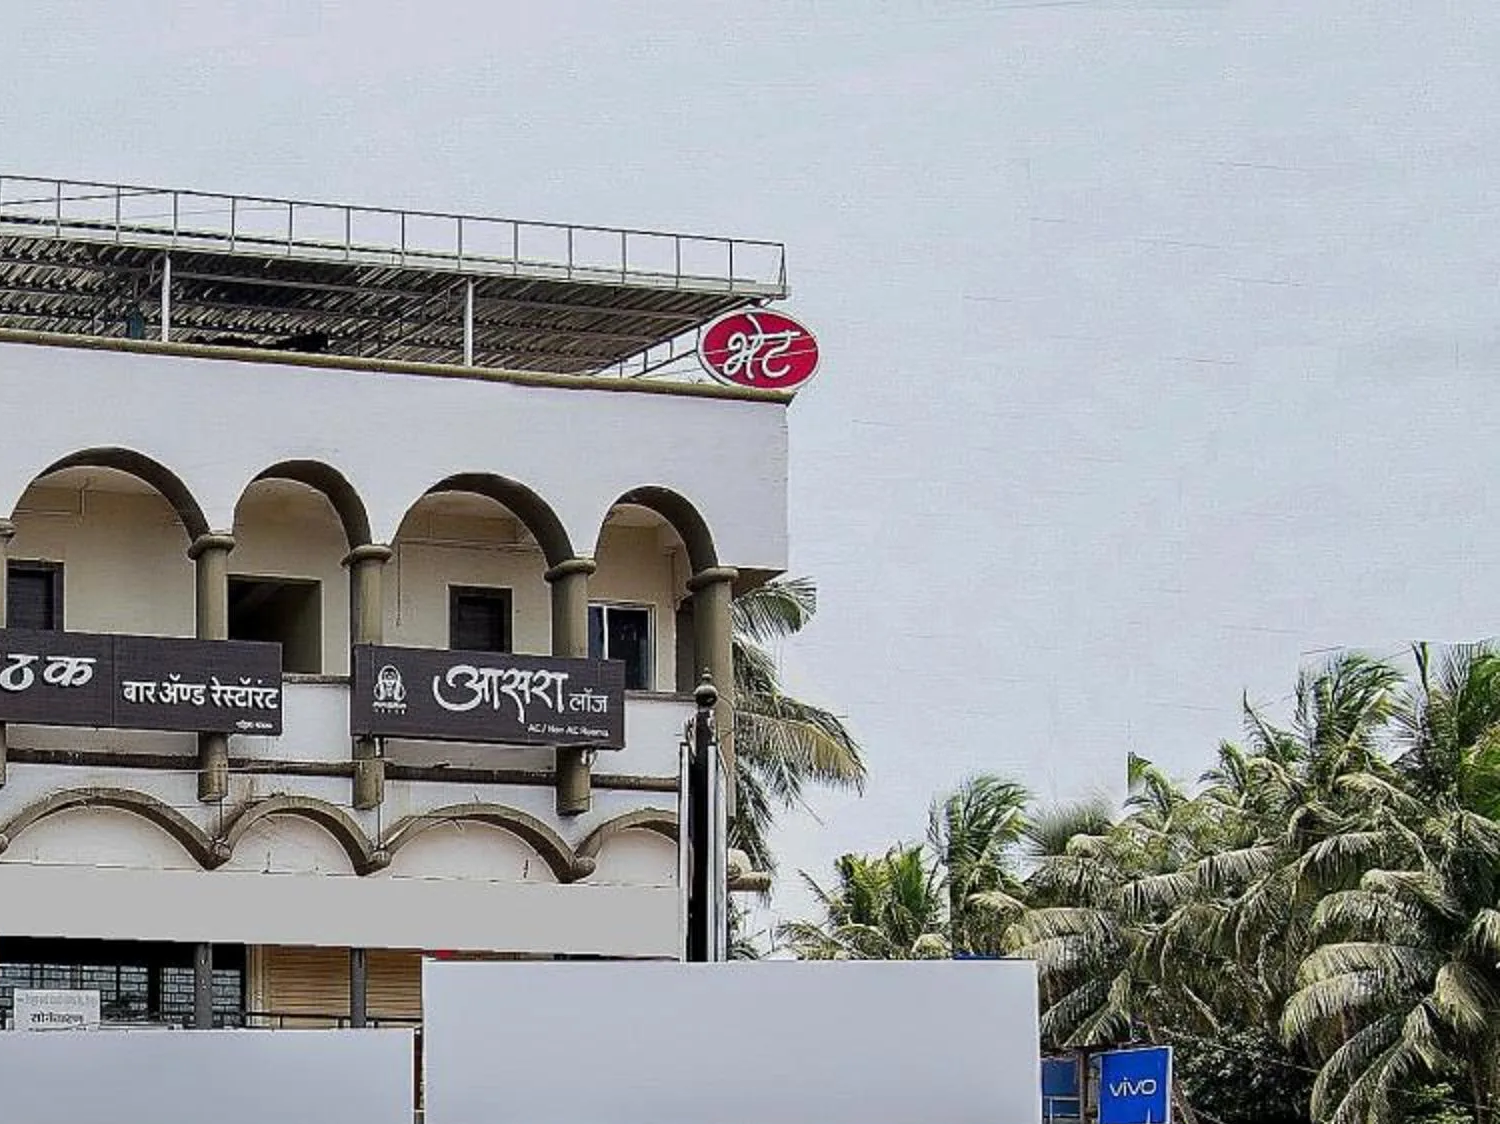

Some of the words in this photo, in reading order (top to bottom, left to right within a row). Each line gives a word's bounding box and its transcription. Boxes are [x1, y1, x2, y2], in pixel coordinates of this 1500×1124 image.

[723, 314, 800, 380] भेट
[122, 680, 157, 703] बार
[433, 665, 569, 724] आसरा
[569, 688, 609, 713] लॉज
[1109, 1076, 1157, 1097] vivo
